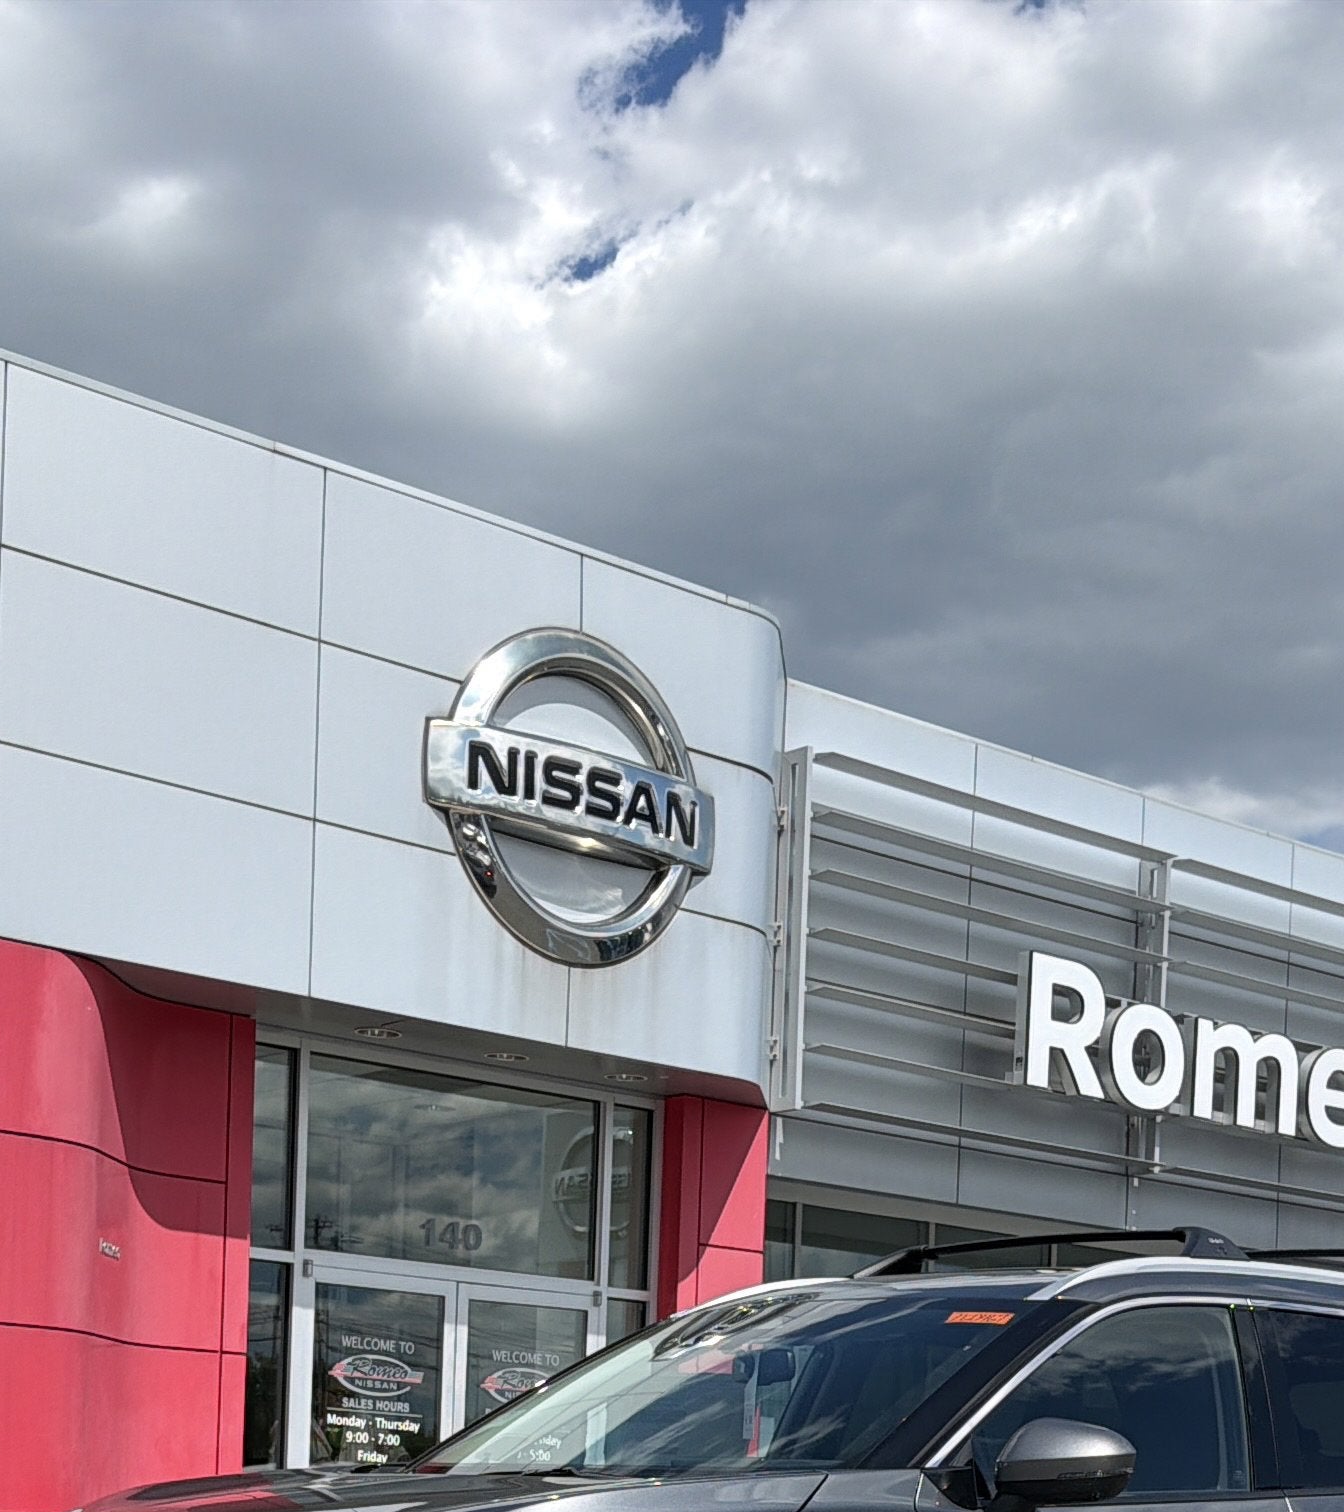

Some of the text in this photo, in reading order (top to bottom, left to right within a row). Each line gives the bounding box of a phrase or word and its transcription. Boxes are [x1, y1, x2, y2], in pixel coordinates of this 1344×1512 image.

[466, 740, 698, 849] NISSAN
[419, 1217, 483, 1251] 140
[341, 1335, 415, 1355] WELCOME TO
[492, 1350, 560, 1367] WELCOME TO
[347, 1357, 408, 1380] Romeo
[354, 1379, 397, 1391] NISSAN
[341, 1396, 410, 1413] SALES HOURS
[326, 1413, 367, 1429] Monday
[375, 1417, 421, 1435] Thursday
[345, 1431, 369, 1444] 9:00
[378, 1433, 401, 1447] 7:00
[357, 1450, 389, 1465] Friday
